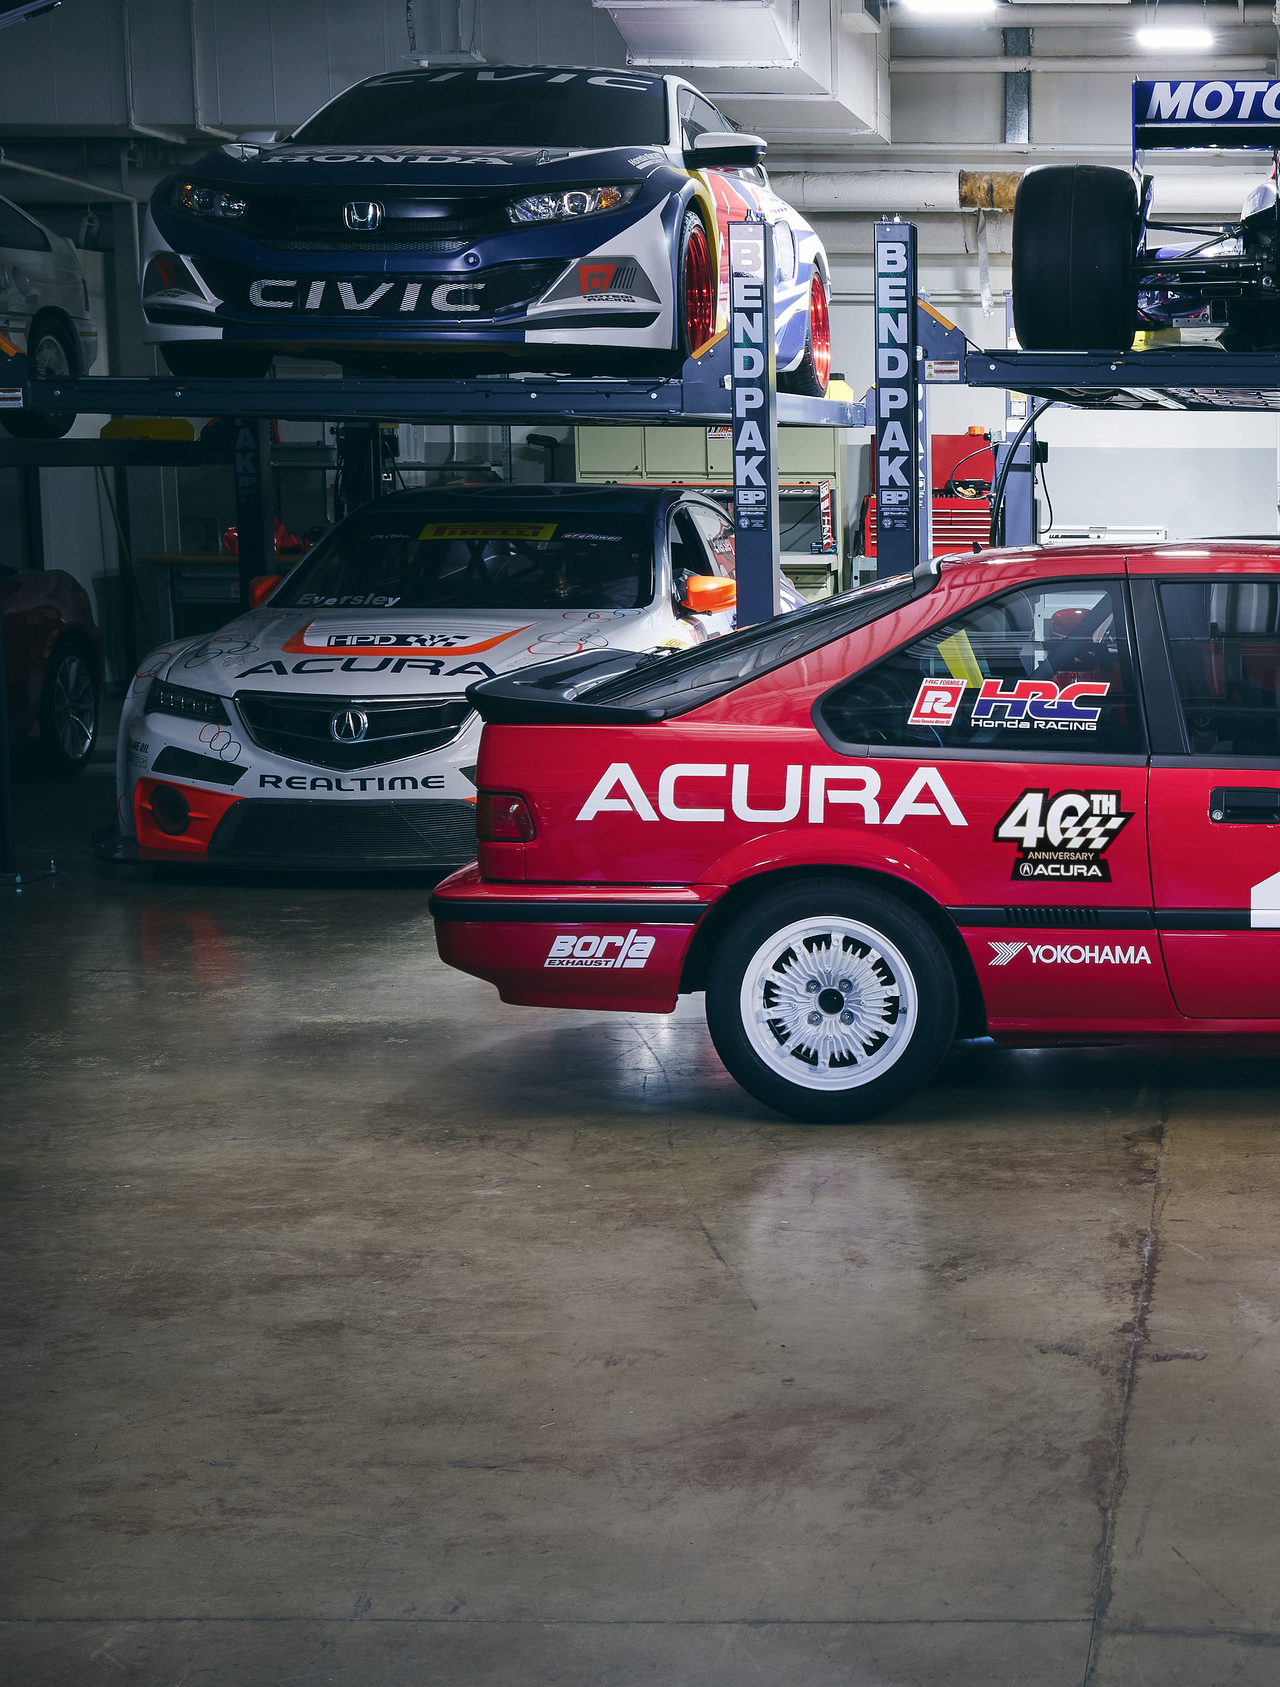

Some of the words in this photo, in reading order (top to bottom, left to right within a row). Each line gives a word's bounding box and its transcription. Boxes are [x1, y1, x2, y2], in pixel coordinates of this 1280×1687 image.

[363, 71, 654, 91] CIVIC
[261, 154, 514, 166] HONDA
[249, 278, 486, 312] CIVIC
[731, 241, 767, 486] BENDPAK
[877, 242, 910, 487] BENDPAK
[432, 525, 545, 537] PIRELLI
[296, 593, 401, 607] Eversley
[329, 635, 397, 646] HPD
[234, 657, 498, 679] ACURA
[971, 678, 1111, 722] HRC
[971, 719, 1030, 729] Honda
[1033, 720, 1097, 731] RACING
[259, 774, 445, 792] REALTIME
[576, 762, 969, 827] ACURA
[1027, 851, 1095, 861] ANNIVERSARY
[1033, 864, 1103, 877] ACURA
[547, 959, 612, 967] EXHAUST
[1027, 944, 1152, 965] YOKOHAMA
